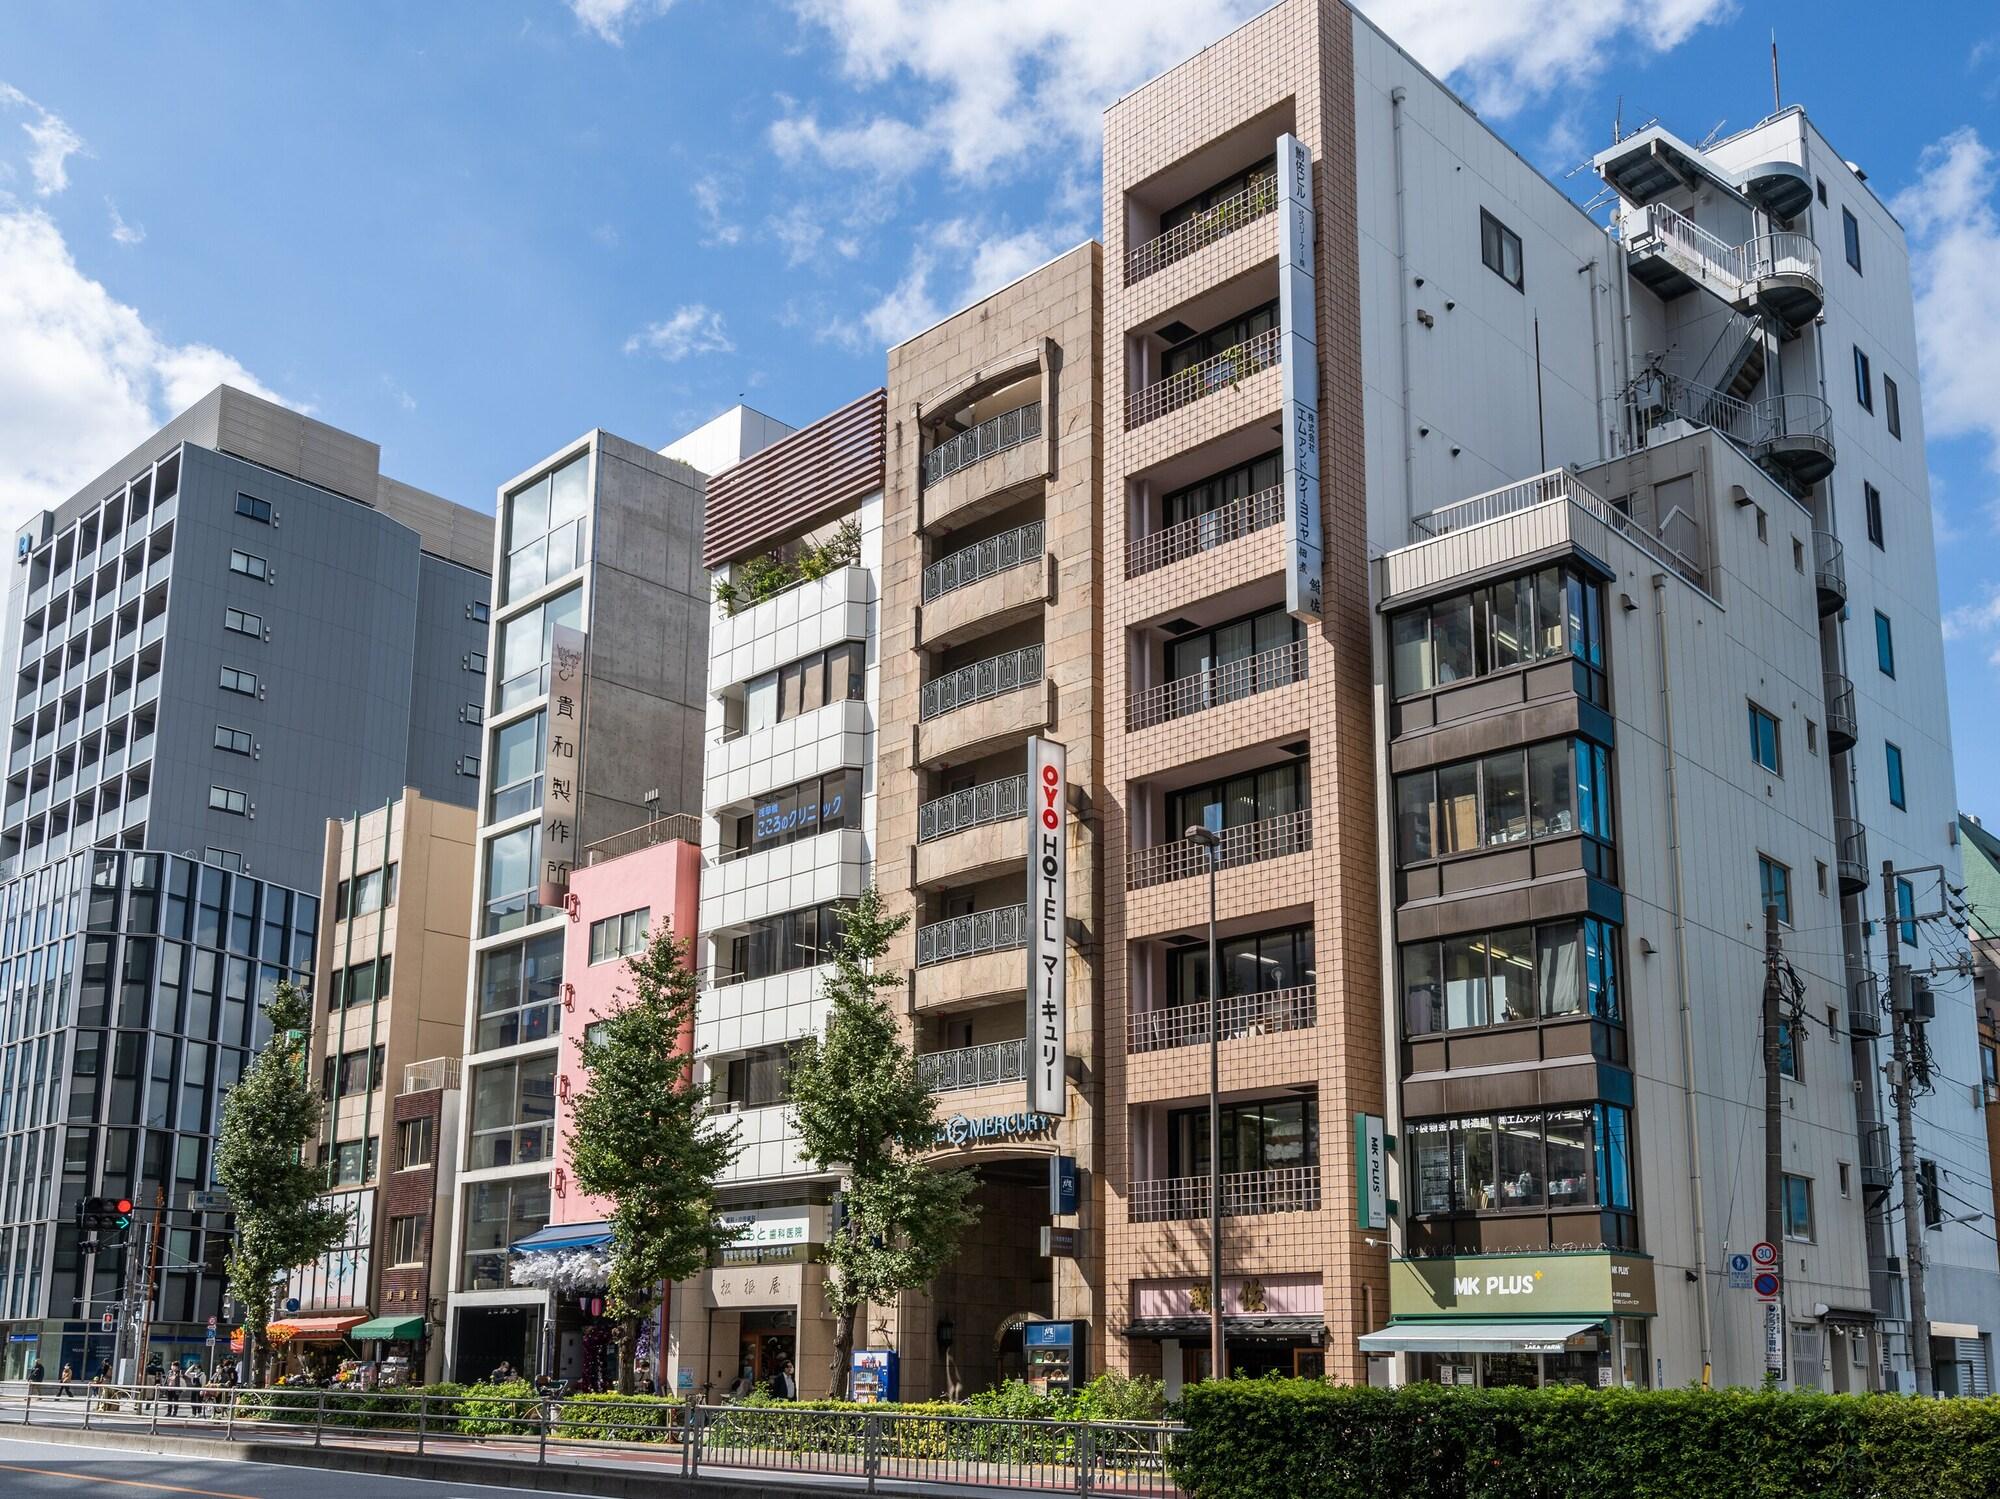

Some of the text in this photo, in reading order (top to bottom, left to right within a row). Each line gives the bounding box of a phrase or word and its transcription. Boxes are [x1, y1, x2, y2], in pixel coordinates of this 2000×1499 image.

[1307, 412, 1316, 454] 株式会社
[547, 695, 576, 885] 貴和製作所
[757, 795, 842, 837] こころのクリニック
[1042, 764, 1058, 1091] OYO HOTEL マーキュリー
[969, 1113, 1048, 1138] MERCURY
[1370, 1136, 1380, 1193] MK PLUS
[1757, 1248, 1772, 1259] 30
[1454, 1275, 1534, 1296] MK PLUS
